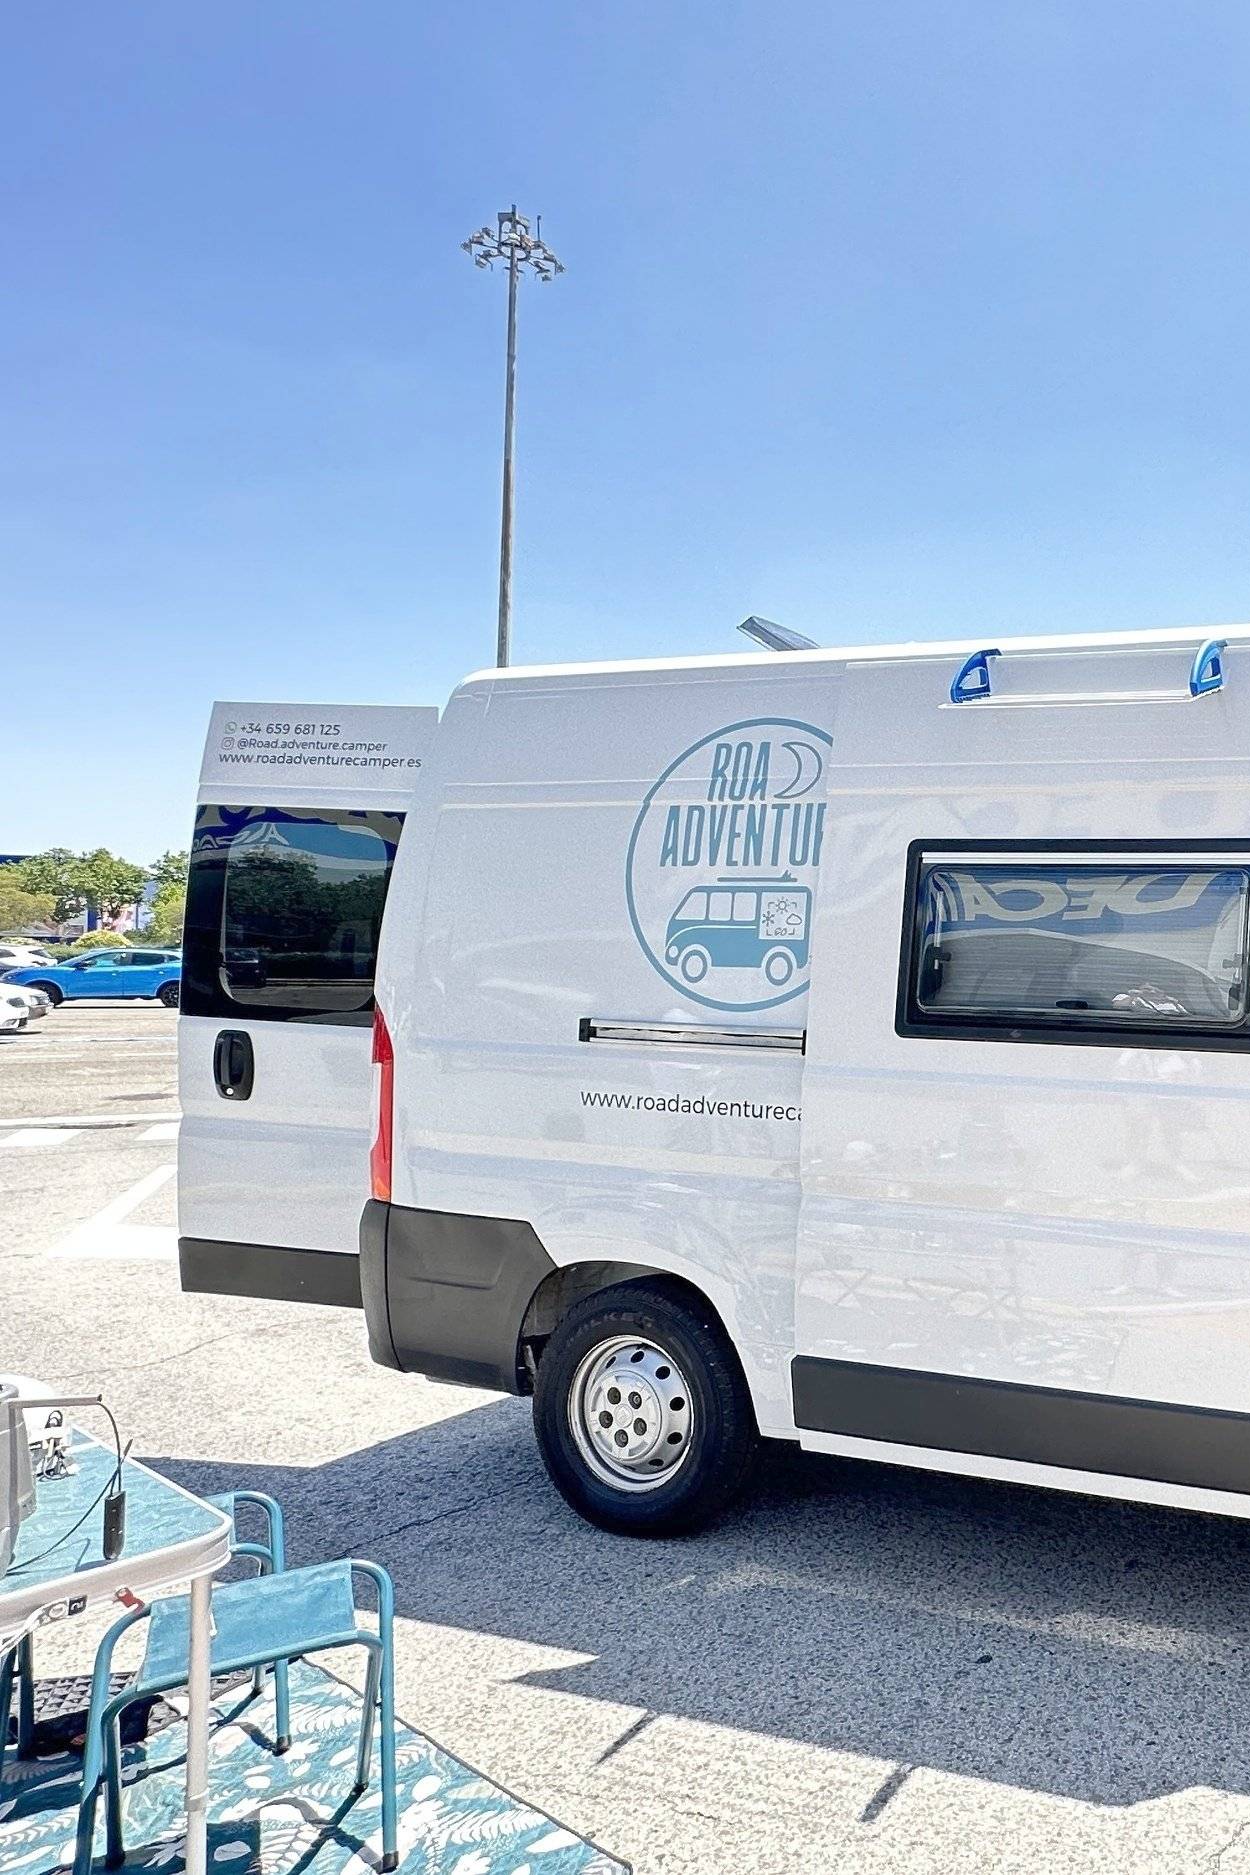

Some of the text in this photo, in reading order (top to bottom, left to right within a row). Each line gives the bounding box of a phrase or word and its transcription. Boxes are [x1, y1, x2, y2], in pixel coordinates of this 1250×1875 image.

[240, 723, 341, 736] +34 659 681 125
[237, 739, 388, 752] @Road.adventure.camper
[218, 752, 422, 768] www.roadadventurecamper.es
[707, 742, 771, 802] ROA
